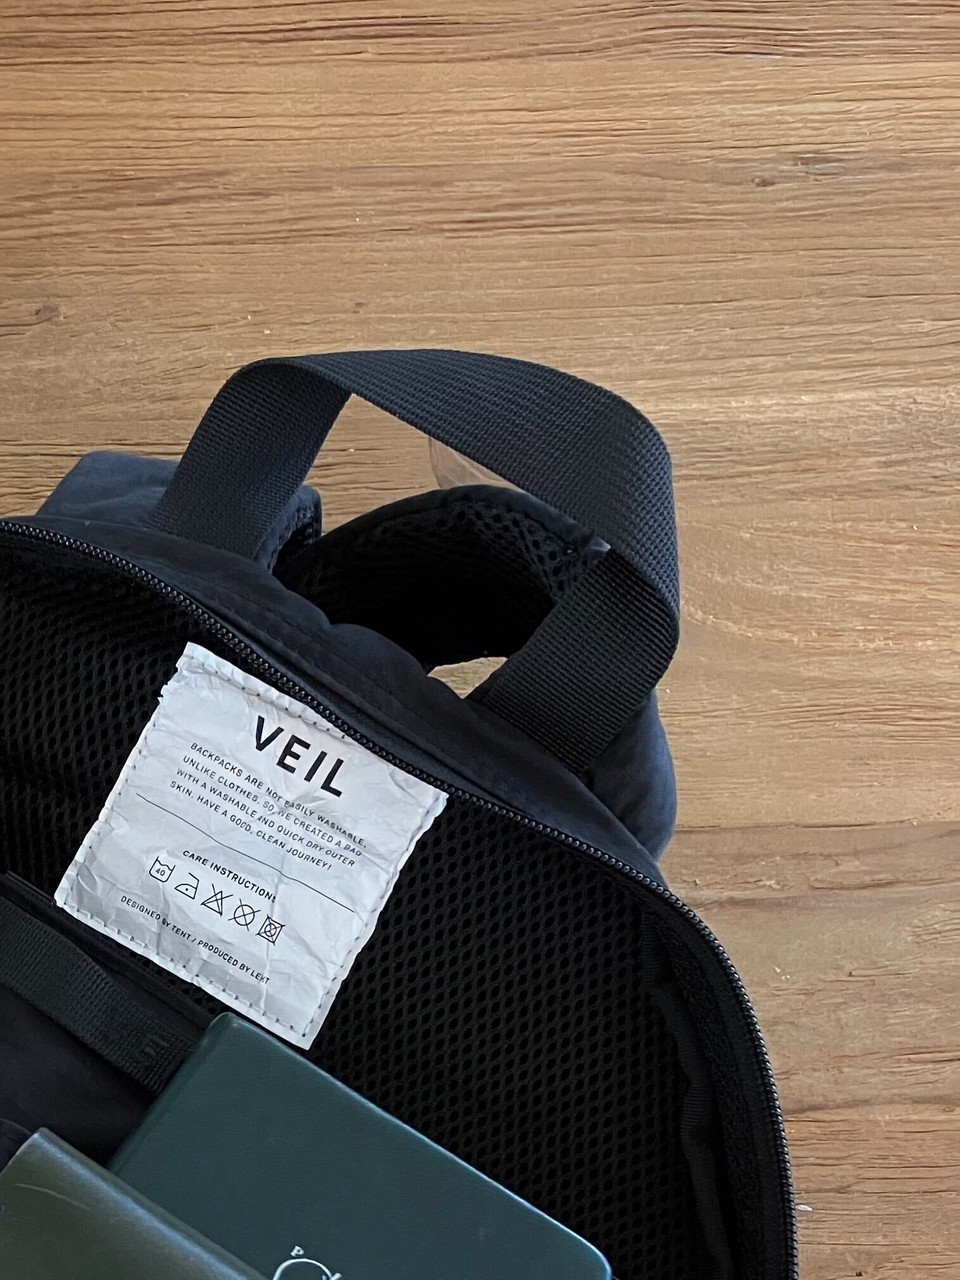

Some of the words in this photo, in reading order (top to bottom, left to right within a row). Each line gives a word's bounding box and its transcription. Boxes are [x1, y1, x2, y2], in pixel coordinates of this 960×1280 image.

[190, 742, 243, 777] BACKPACKS
[244, 775, 264, 790] ARE
[266, 787, 282, 802] NOT
[284, 800, 315, 817] EASILY
[317, 814, 367, 848] WASHABLE.
[255, 715, 344, 798] VEIL
[176, 768, 200, 785] WITH
[201, 782, 207, 790] A
[209, 785, 258, 818] WASHABLE
[257, 815, 275, 828] AND
[277, 825, 304, 845] QUICK
[306, 840, 322, 852] DRY
[325, 849, 356, 867] OUTER
[183, 755, 217, 779] UNLIKE
[218, 776, 260, 804] CLOTHES.
[293, 817, 334, 843] CREATED
[335, 839, 341, 848] A
[344, 844, 363, 857] BAG
[197, 795, 221, 813] HAVE
[256, 830, 286, 849] CLEAN
[286, 845, 332, 870] JOURNEY!
[155, 868, 166, 877] 40
[182, 850, 209, 866] CARE
[120, 895, 161, 920] DESIGNED
[161, 918, 171, 928] BY
[171, 925, 192, 940] TENT
[198, 940, 239, 967] PRODUCED
[239, 963, 251, 973] BY
